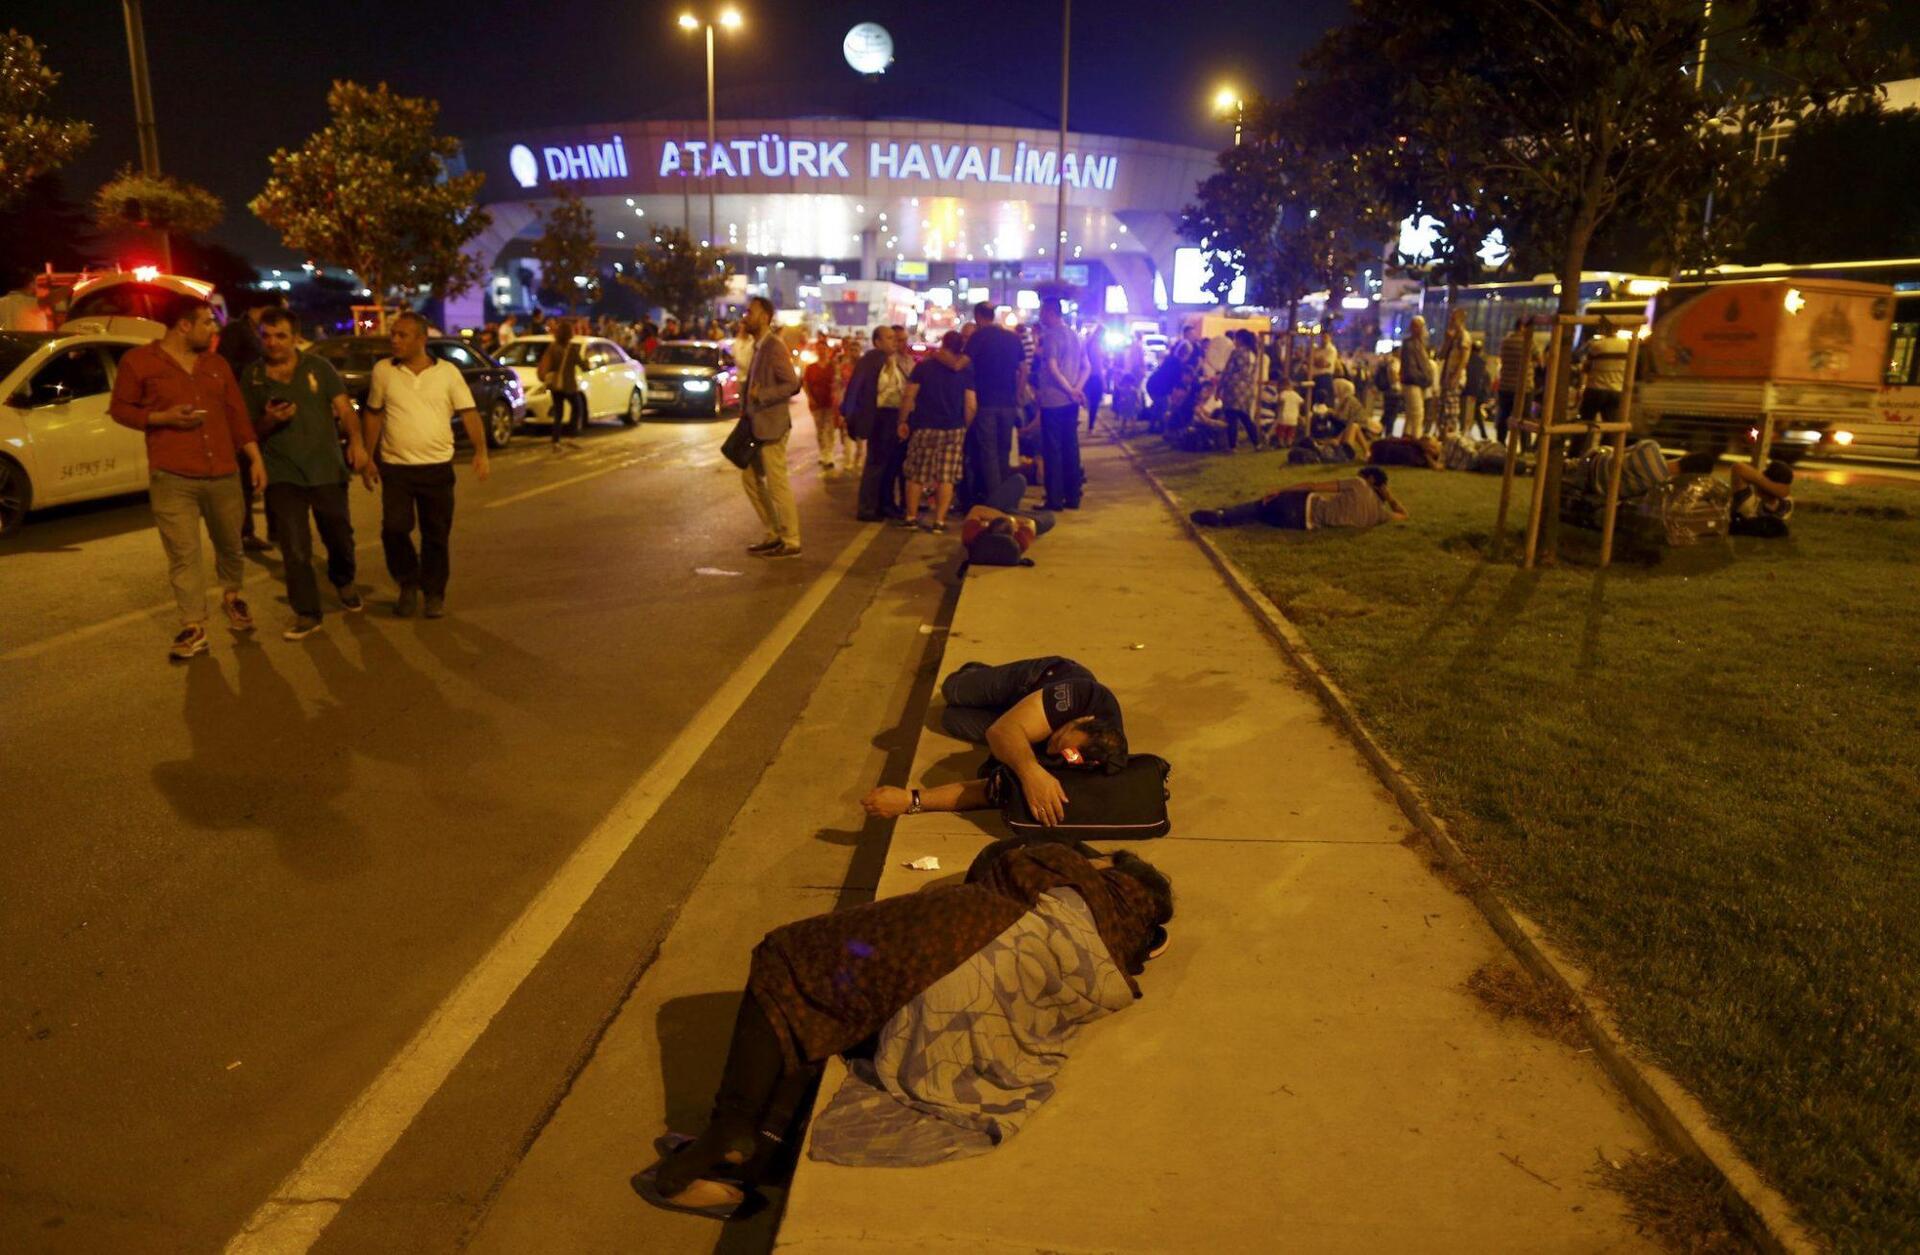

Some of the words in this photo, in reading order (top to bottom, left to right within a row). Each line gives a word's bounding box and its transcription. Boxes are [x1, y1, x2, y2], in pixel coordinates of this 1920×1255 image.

[543, 135, 628, 181] DHMİ
[659, 134, 849, 177] ATATÜRK
[869, 141, 1118, 190] HAVALİMANI
